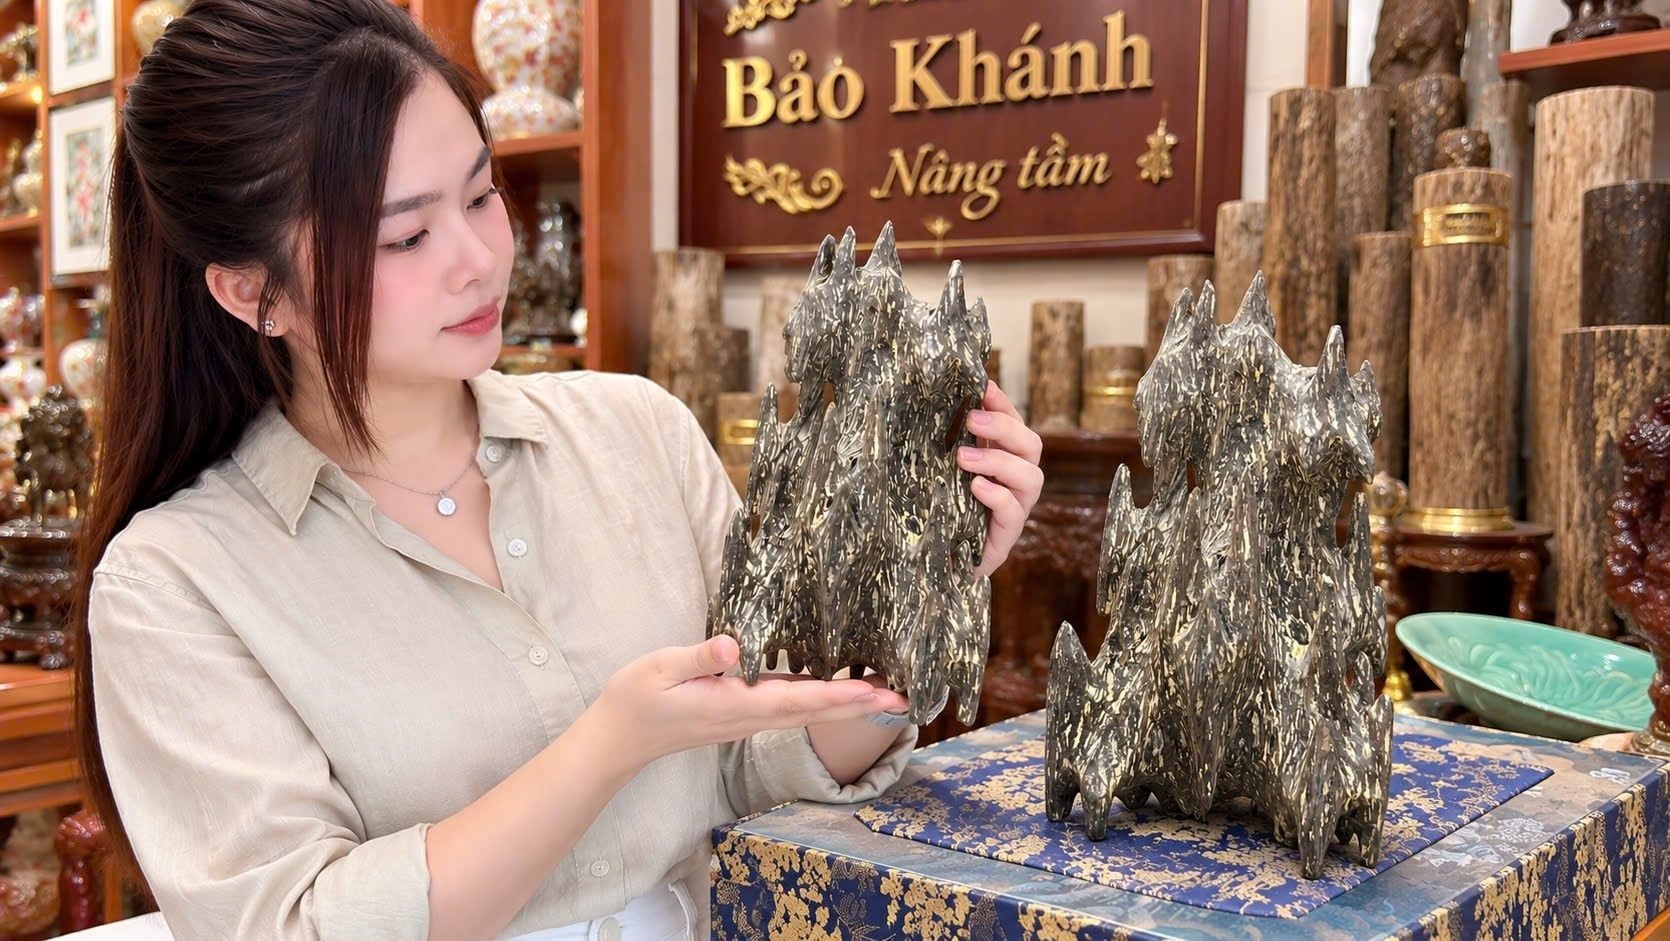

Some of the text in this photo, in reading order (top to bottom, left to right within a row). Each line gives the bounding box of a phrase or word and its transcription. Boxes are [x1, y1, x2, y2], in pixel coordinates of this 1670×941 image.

[889, 9, 1154, 113] Khánh
[869, 132, 1112, 220] Nâng tầm
